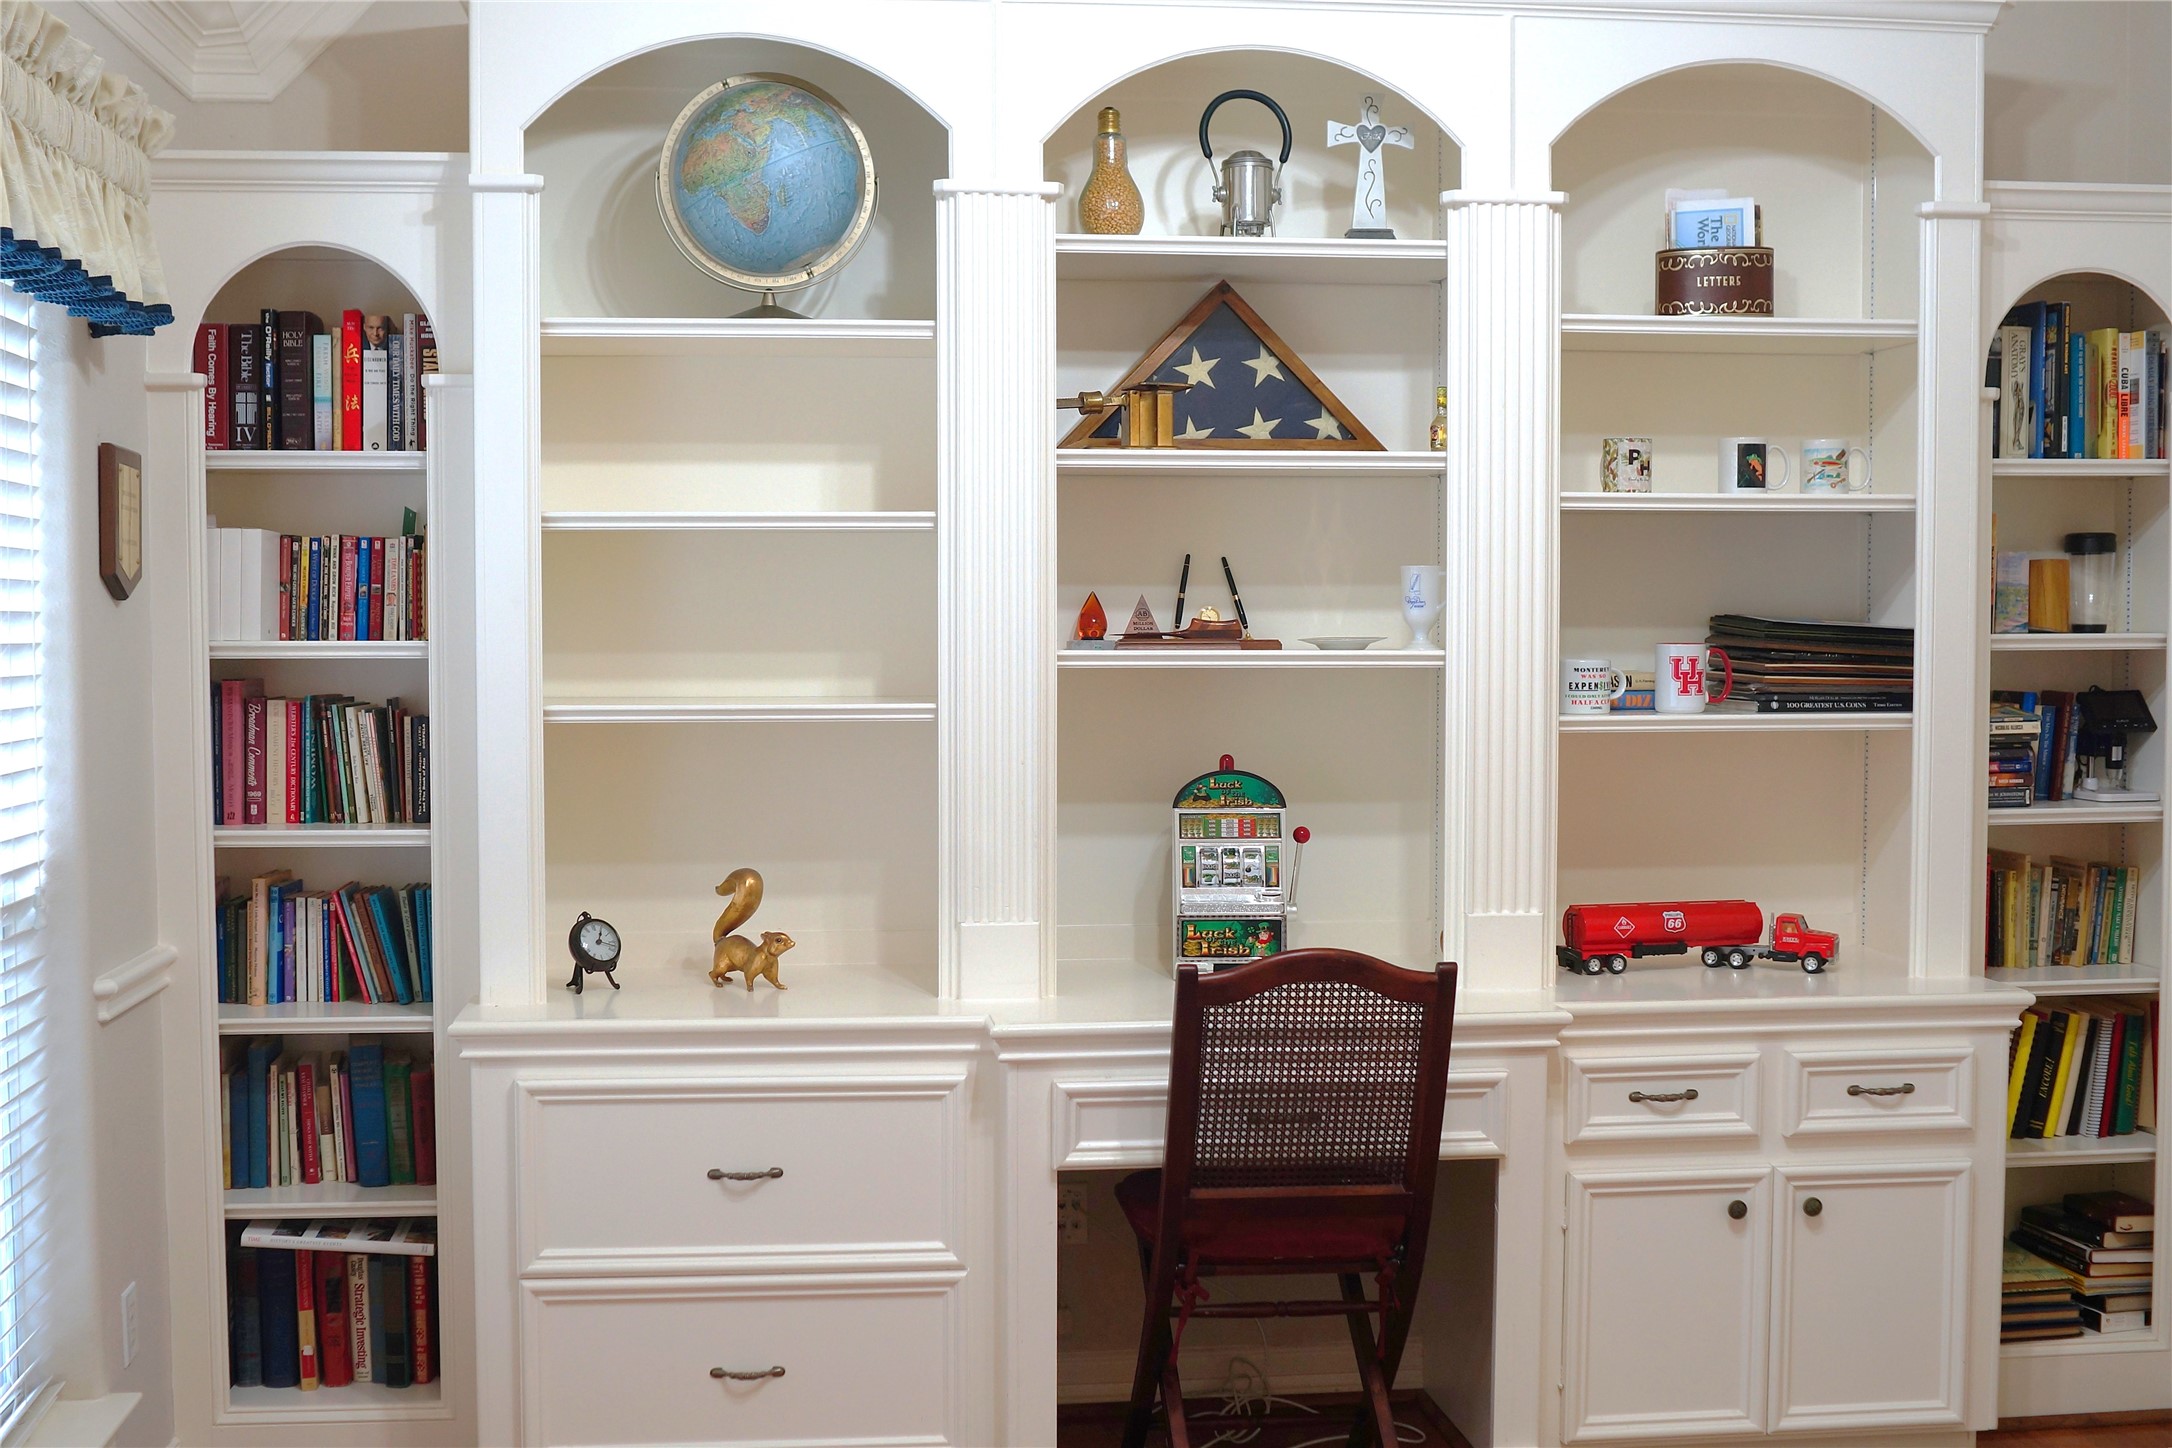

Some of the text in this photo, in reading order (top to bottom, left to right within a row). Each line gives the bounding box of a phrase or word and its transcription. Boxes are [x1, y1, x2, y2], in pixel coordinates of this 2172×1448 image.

[1697, 217, 1709, 247] Wor
[1710, 216, 1723, 242] The
[1696, 276, 1741, 287] LETTERS
[240, 330, 252, 383] The Bible
[264, 326, 272, 361] O'Reilly
[206, 328, 216, 436] Faith Comes By Hearing
[409, 374, 415, 382] Do
[2120, 367, 2129, 418] CUBA LIBRE
[235, 426, 256, 442] IV
[1628, 449, 1640, 465] P
[1669, 656, 1704, 696] UH
[1626, 694, 1653, 707] DIZ
[247, 703, 261, 786] Broadman Comments
[1208, 777, 1243, 790] Luck
[1220, 795, 1254, 806] Irish
[1186, 924, 1236, 940] Luck
[1667, 919, 1682, 928] 66
[1201, 941, 1251, 956] Irish
[2040, 1056, 2055, 1098] ENCORE!
[2125, 1040, 2138, 1106] Talk About Good!
[352, 1283, 368, 1369] Strategic Investing
